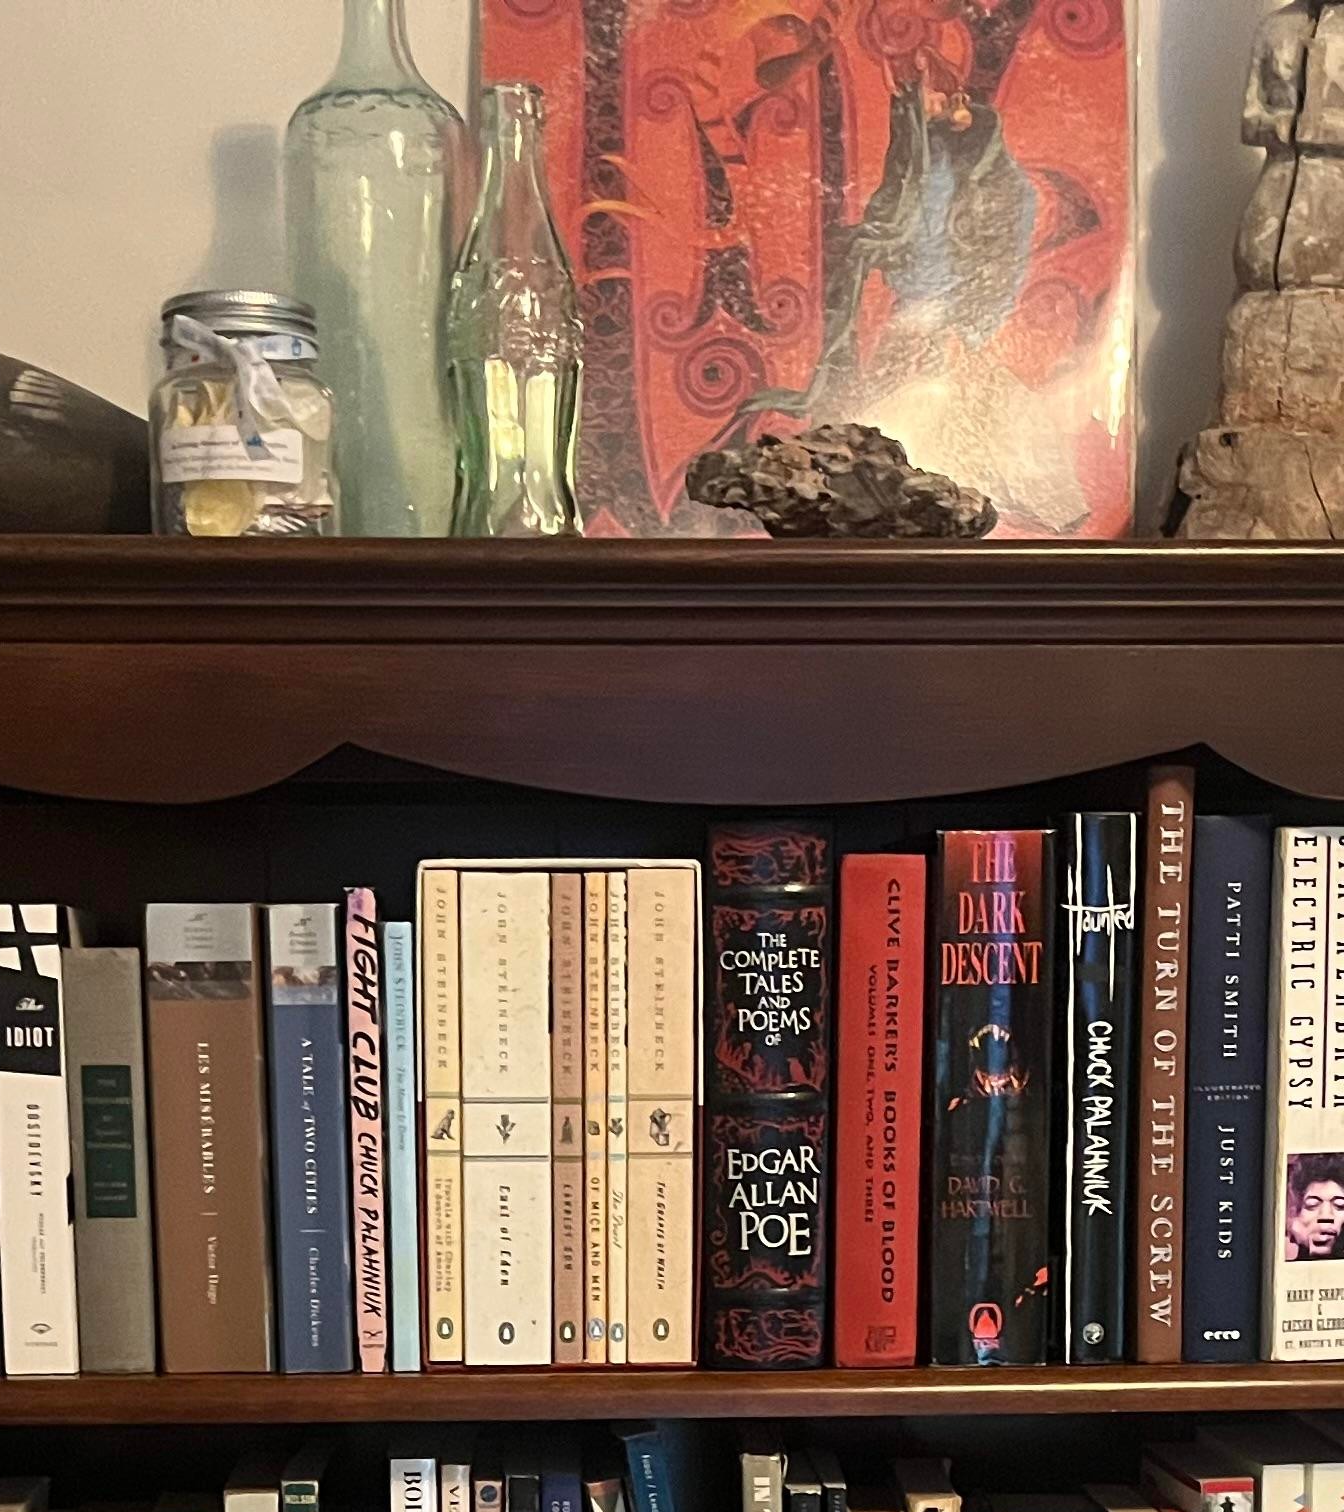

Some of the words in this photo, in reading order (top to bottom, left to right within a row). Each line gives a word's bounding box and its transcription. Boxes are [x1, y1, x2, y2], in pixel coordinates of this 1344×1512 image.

[968, 838, 1017, 884] THE
[1159, 800, 1184, 885] THE
[756, 932, 787, 948] THE
[886, 878, 901, 948] CLIVE
[958, 890, 1026, 935] DARK
[1225, 881, 1242, 958] PATTI
[1290, 835, 1317, 990] ELECTRIC
[351, 913, 379, 1025] FIGHT
[720, 948, 820, 972] COMPLETE
[738, 971, 804, 996] TALES
[941, 941, 1042, 986] DESCENT
[1154, 902, 1181, 1012] TURN
[498, 958, 508, 1073] STEINBECK
[738, 1007, 811, 1034] POEMS
[757, 996, 790, 1009] AND
[884, 958, 900, 1073] BARKER'S
[1223, 974, 1240, 1058] SMITH
[6, 1026, 54, 1048] IDIOT
[765, 1033, 782, 1046] OF
[1087, 1021, 1114, 1088] CHUCK
[1153, 1029, 1177, 1077] OF
[1288, 1016, 1314, 1108] GYPSY
[351, 1031, 379, 1120] CLUB
[727, 1145, 820, 1180] EDGAR
[882, 1091, 897, 1173] BOOKS
[1081, 1095, 1114, 1216] PALAHNIUK
[1151, 1095, 1175, 1176] THE
[1218, 1125, 1235, 1185] JUST
[357, 1132, 378, 1198] CHUCK
[728, 1178, 818, 1209] ALLAN
[882, 1181, 896, 1211] OF
[590, 1203, 601, 1233] MICE
[740, 1212, 811, 1256] POE
[1217, 1200, 1234, 1260] KIDS
[358, 1206, 382, 1317] PALAHNIUK
[880, 1220, 896, 1304] BLOOD
[1150, 1194, 1173, 1328] SCREW
[1286, 1289, 1314, 1302] HARRY
